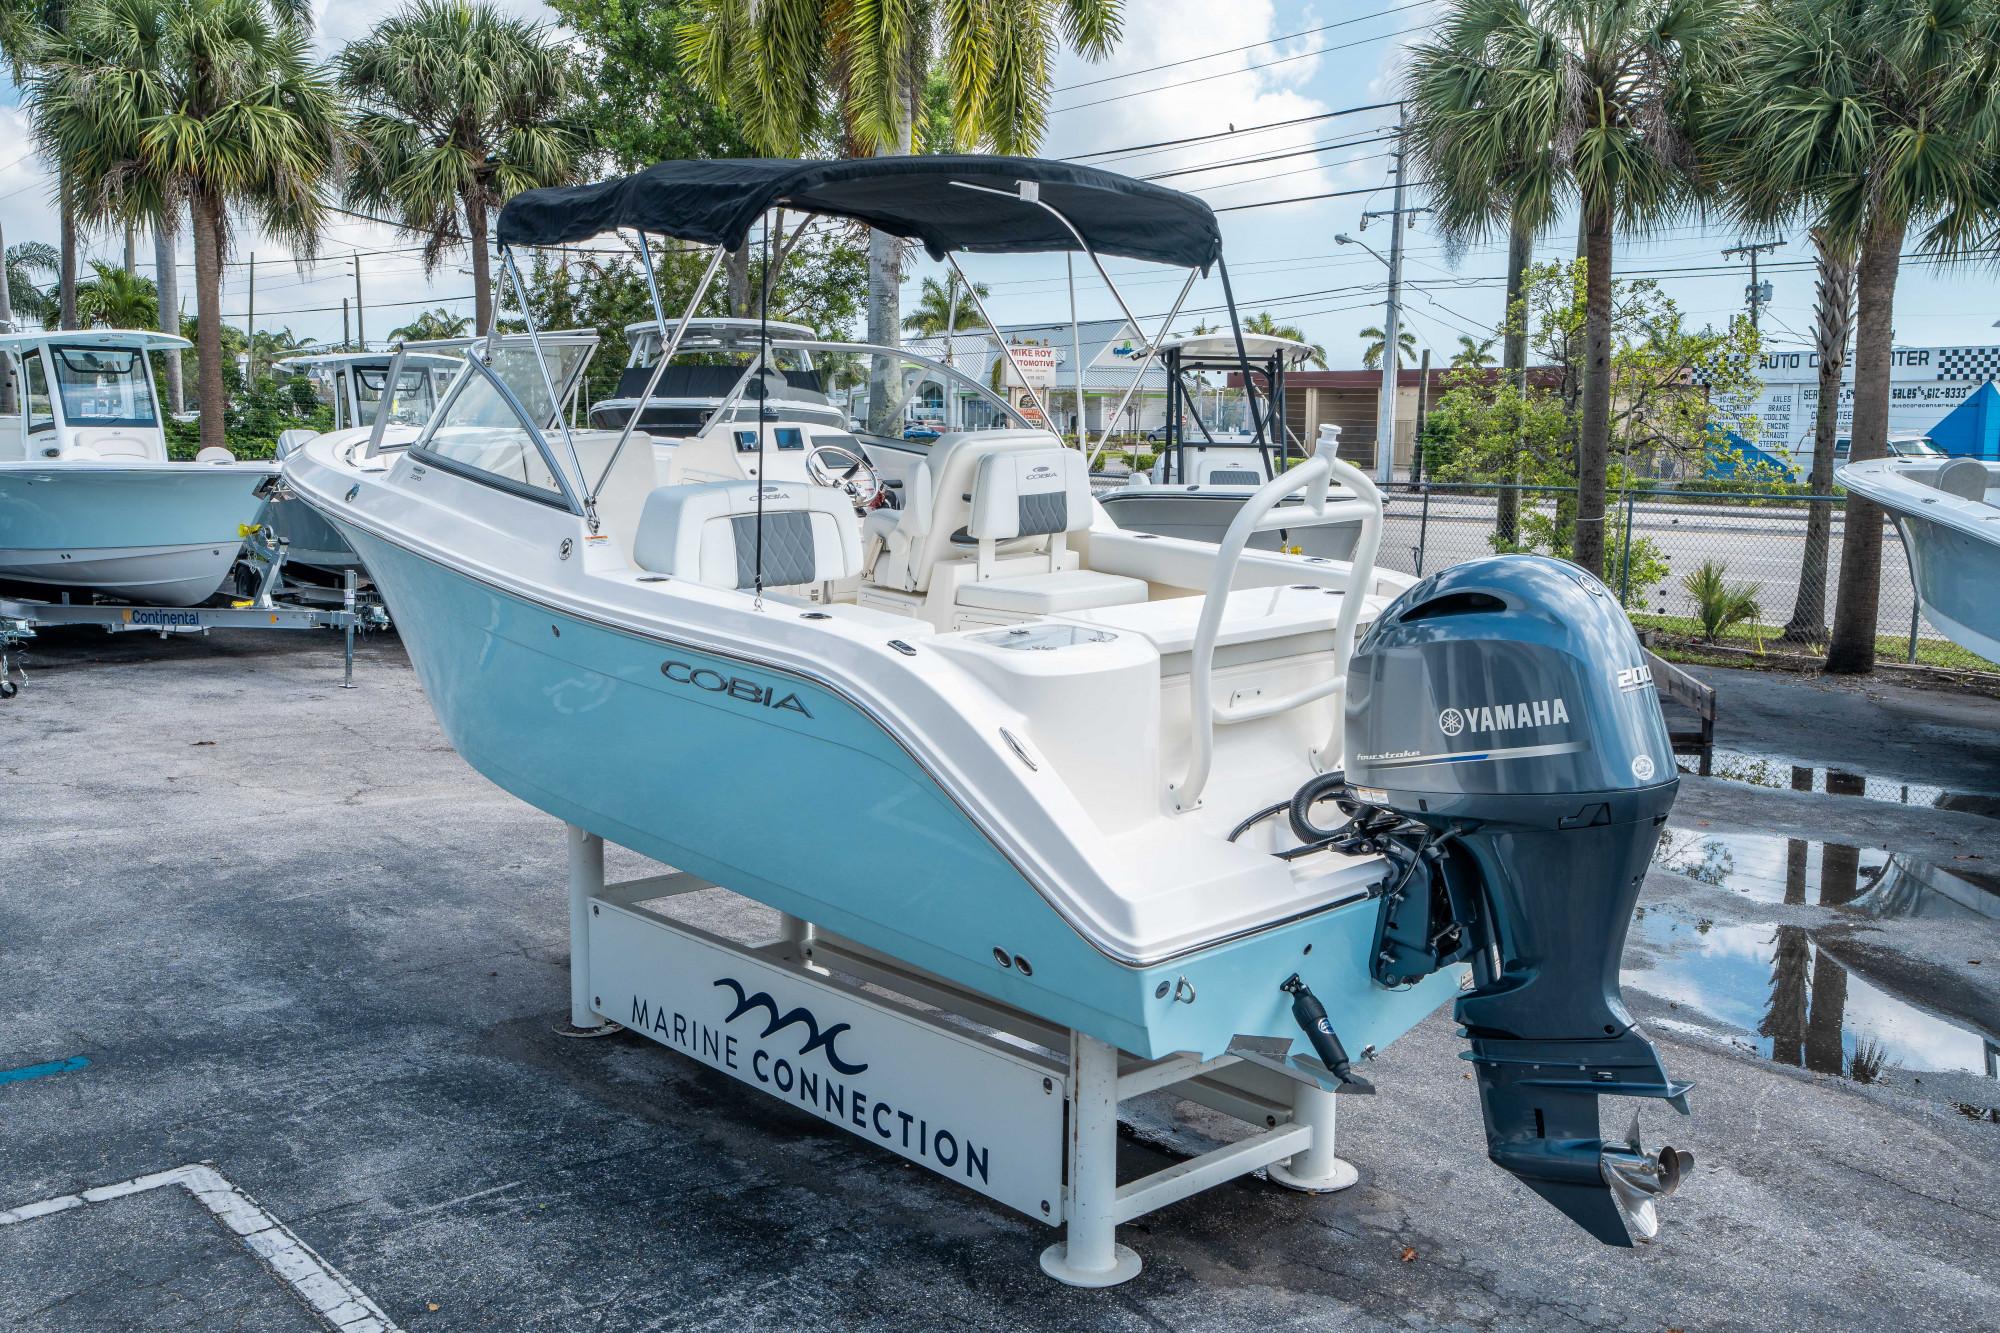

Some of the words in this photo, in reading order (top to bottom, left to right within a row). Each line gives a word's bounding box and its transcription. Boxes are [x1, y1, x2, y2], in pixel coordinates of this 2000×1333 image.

[1011, 348, 1033, 357] MIKE
[1034, 350, 1052, 358] ROY
[1758, 353, 1800, 369] AUTO
[1808, 352, 1852, 368] CE
[1767, 404, 1791, 412] BRAKES
[1763, 413, 1791, 421] COOLING
[1766, 422, 1790, 430] ENGINE
[1762, 431, 1789, 439] EXHAUST
[1758, 440, 1789, 448] STEERING
[1025, 471, 1058, 481] COBIA
[131, 608, 199, 625] Continental
[1617, 664, 1653, 689] 200
[660, 659, 815, 720] COBIA
[1465, 698, 1570, 733] YAMAHA
[631, 994, 739, 1071] MARINE
[752, 1048, 990, 1186] CONNECTION
